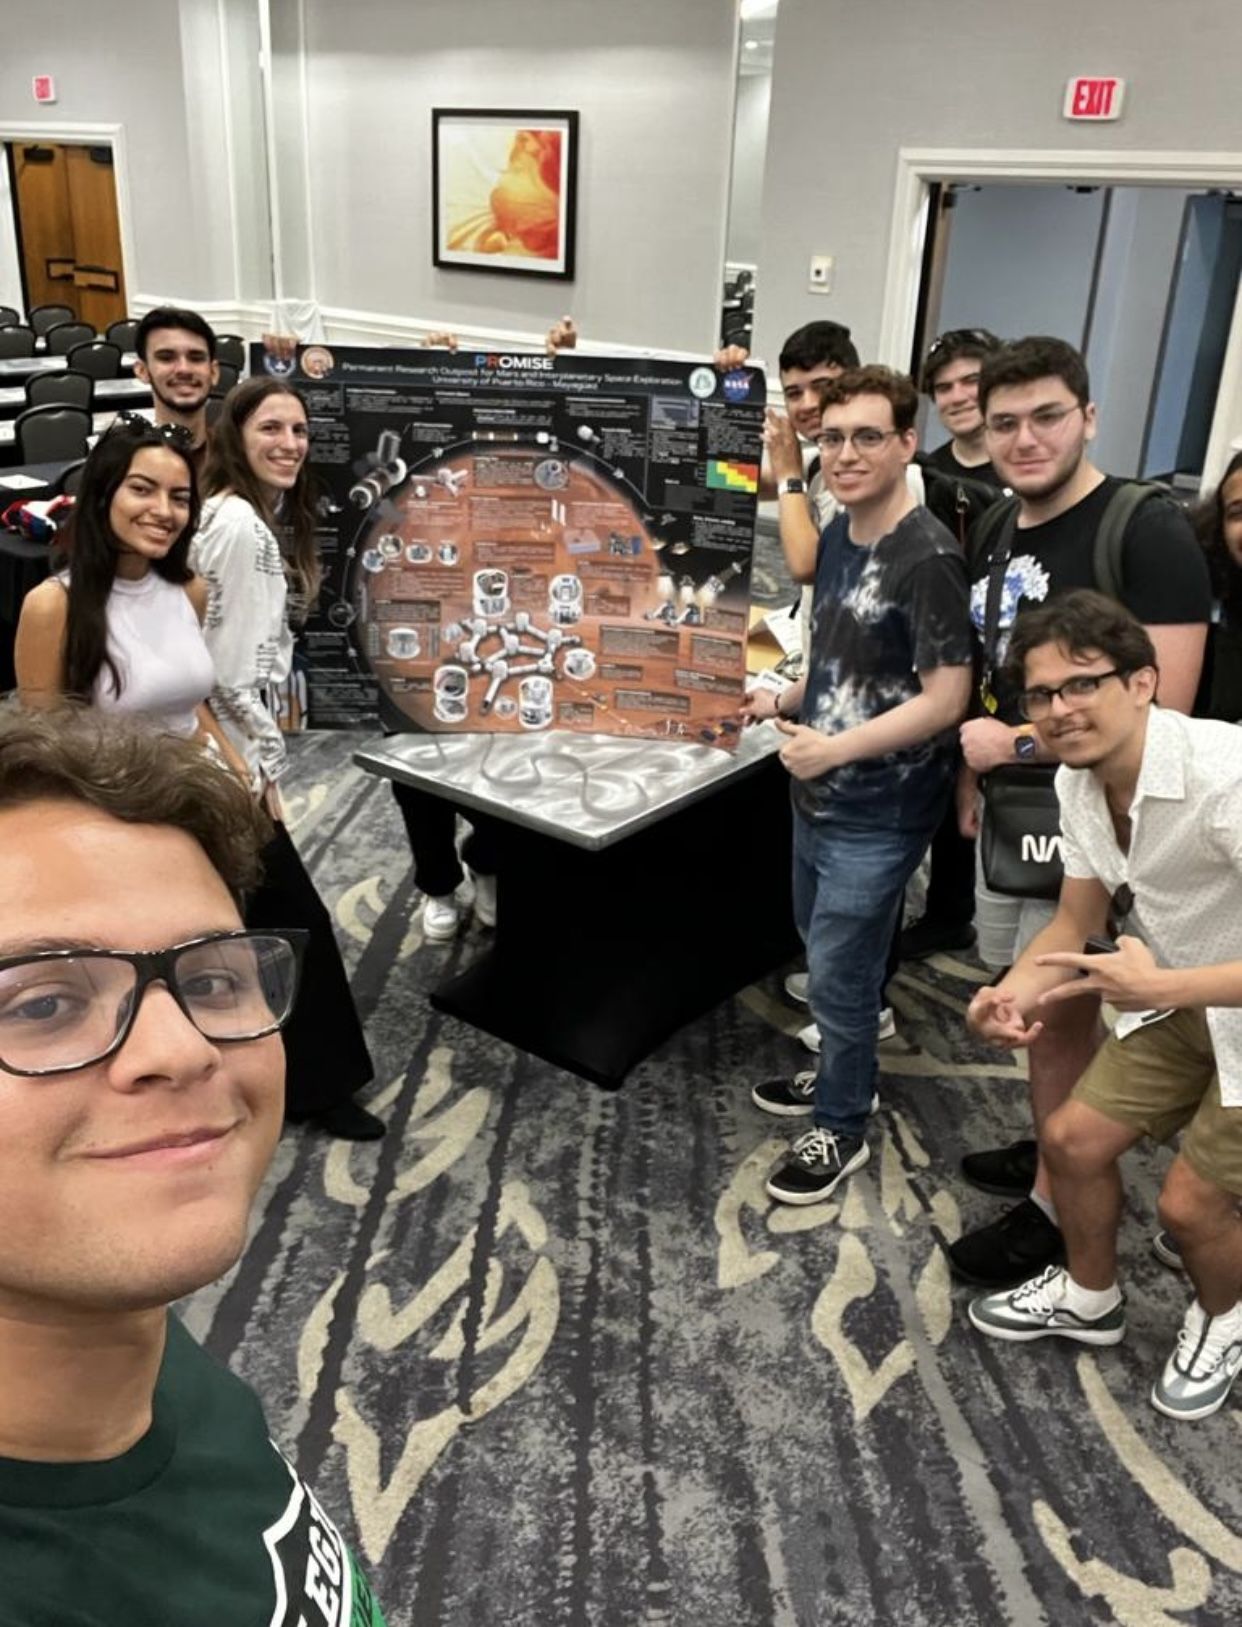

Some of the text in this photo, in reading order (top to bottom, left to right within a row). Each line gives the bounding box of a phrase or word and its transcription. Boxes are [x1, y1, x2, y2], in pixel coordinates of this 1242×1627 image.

[1072, 80, 1116, 116] EXIT
[475, 355, 554, 370] PROMISE
[342, 362, 394, 374] Permanent
[395, 364, 438, 375] Research
[481, 368, 493, 377] for
[496, 369, 518, 378] Mars
[521, 370, 538, 379] and
[540, 371, 603, 383] Interplanetary
[604, 373, 632, 385] Space
[633, 374, 683, 387] Exploration
[432, 376, 478, 387] University
[480, 377, 491, 386] of
[492, 378, 524, 387] Puerto
[525, 379, 546, 388] Rico
[724, 380, 750, 390] NASA
